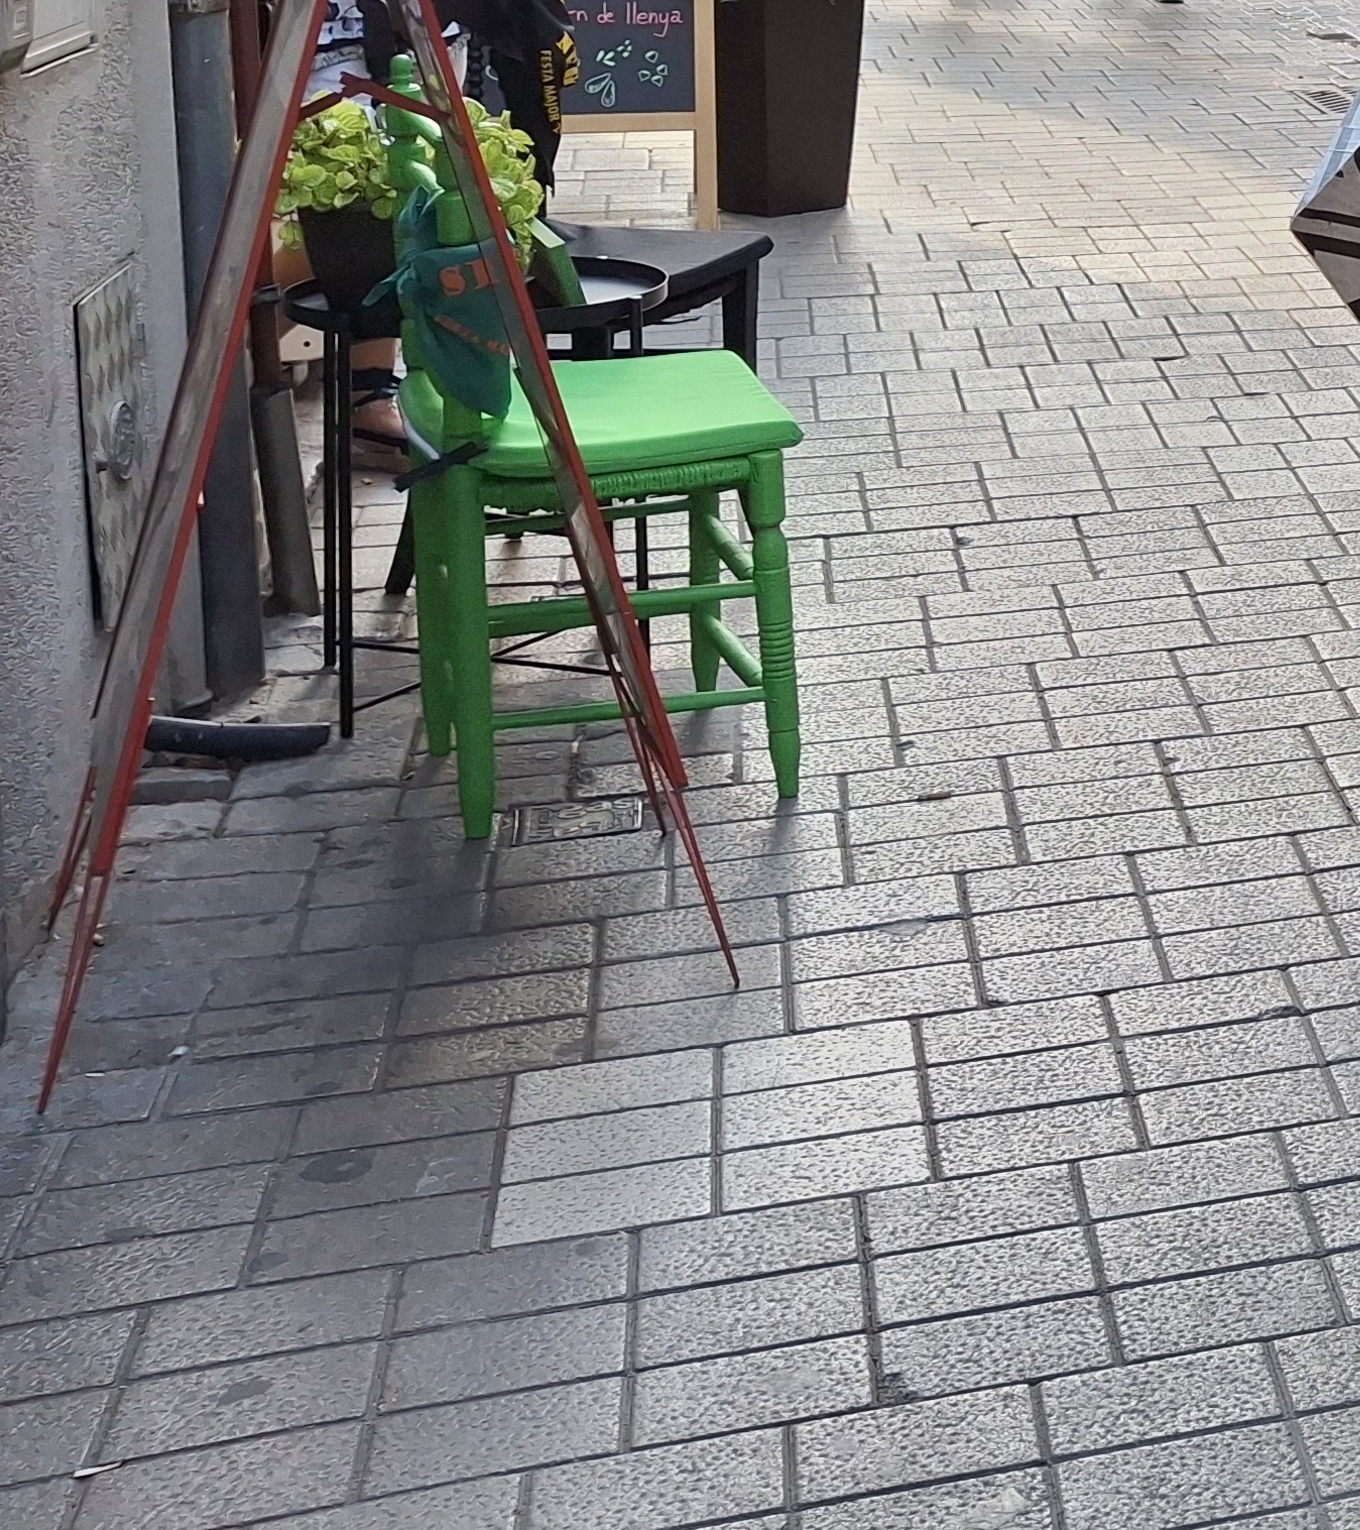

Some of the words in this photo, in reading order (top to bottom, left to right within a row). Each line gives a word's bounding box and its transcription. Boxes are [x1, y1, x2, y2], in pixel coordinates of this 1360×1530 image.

[596, 1, 615, 24] de
[626, 1, 684, 38] llenya
[540, 50, 555, 83] FESTA
[543, 85, 561, 123] MAJOR
